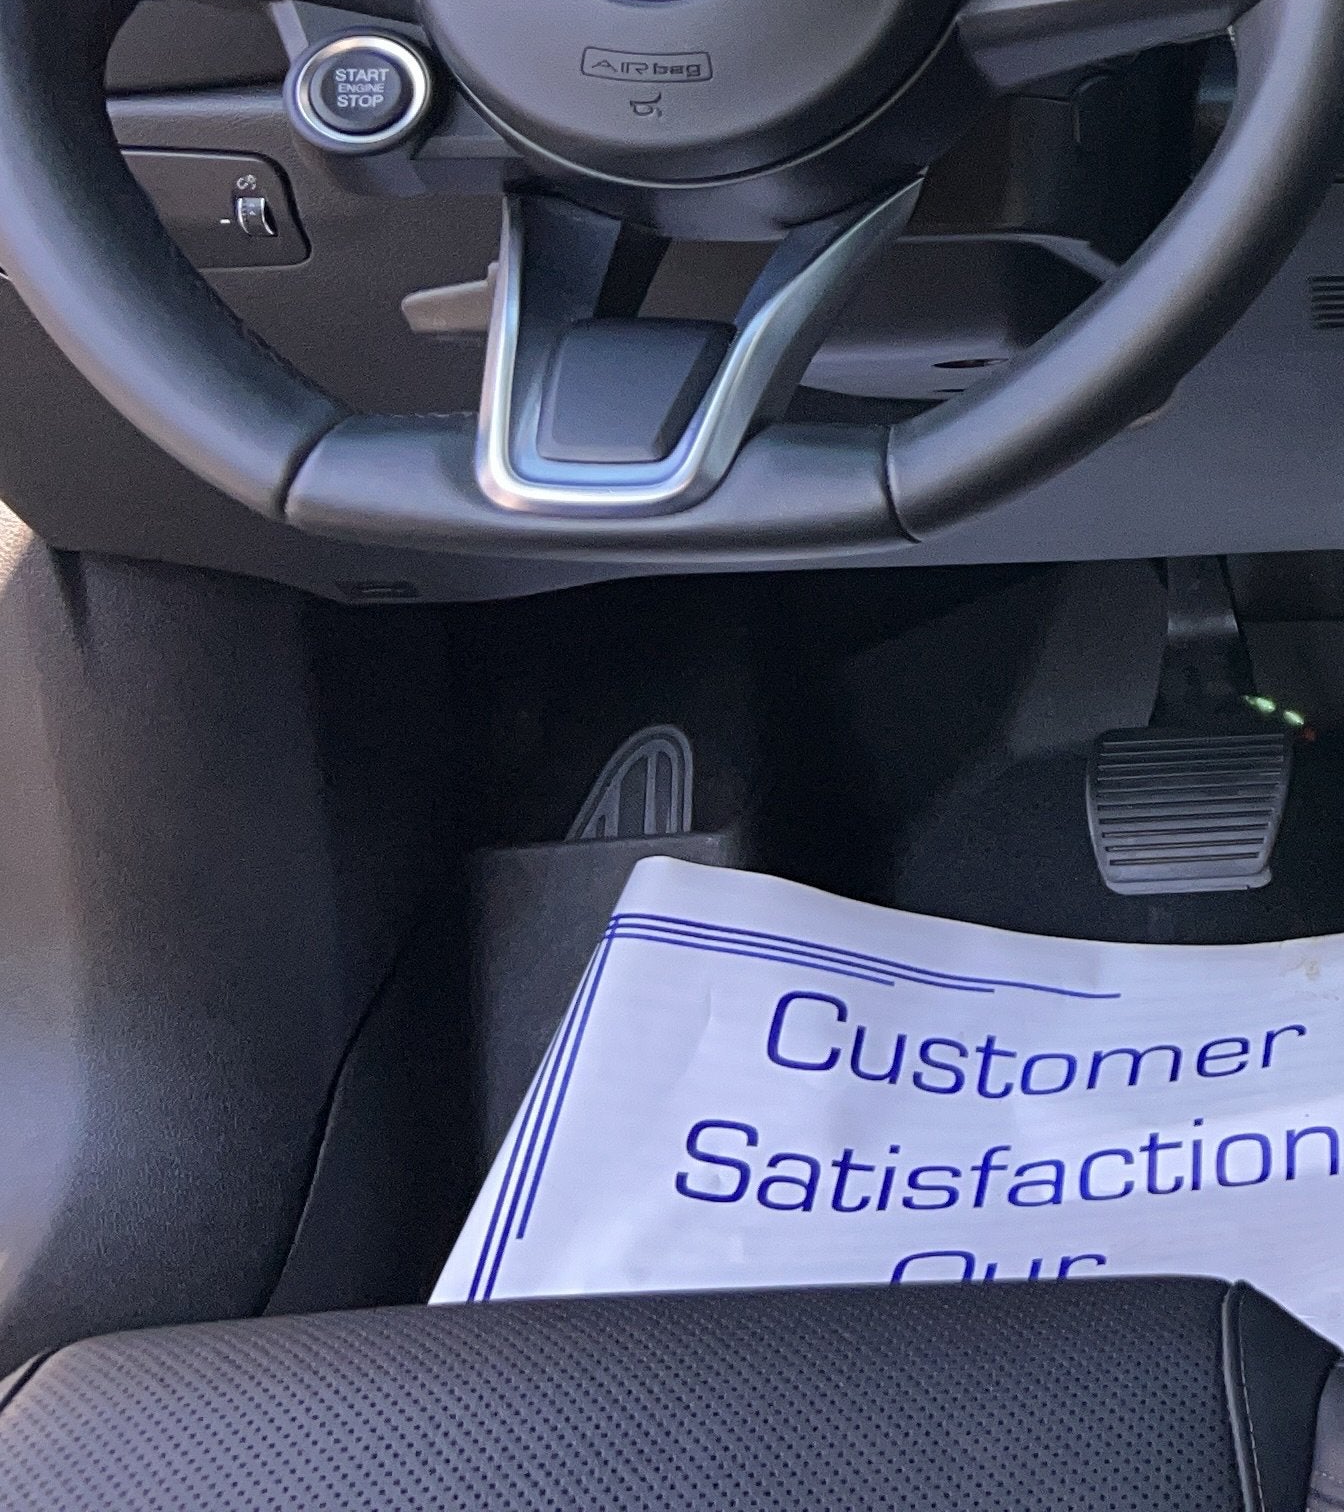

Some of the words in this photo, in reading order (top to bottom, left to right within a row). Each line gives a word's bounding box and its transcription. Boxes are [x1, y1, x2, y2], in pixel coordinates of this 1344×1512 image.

[334, 68, 390, 83] START
[337, 83, 386, 94] ENGINE
[336, 93, 385, 108] STOP
[765, 990, 1308, 1099] Customer
[673, 1115, 1342, 1214] Satisfaction
